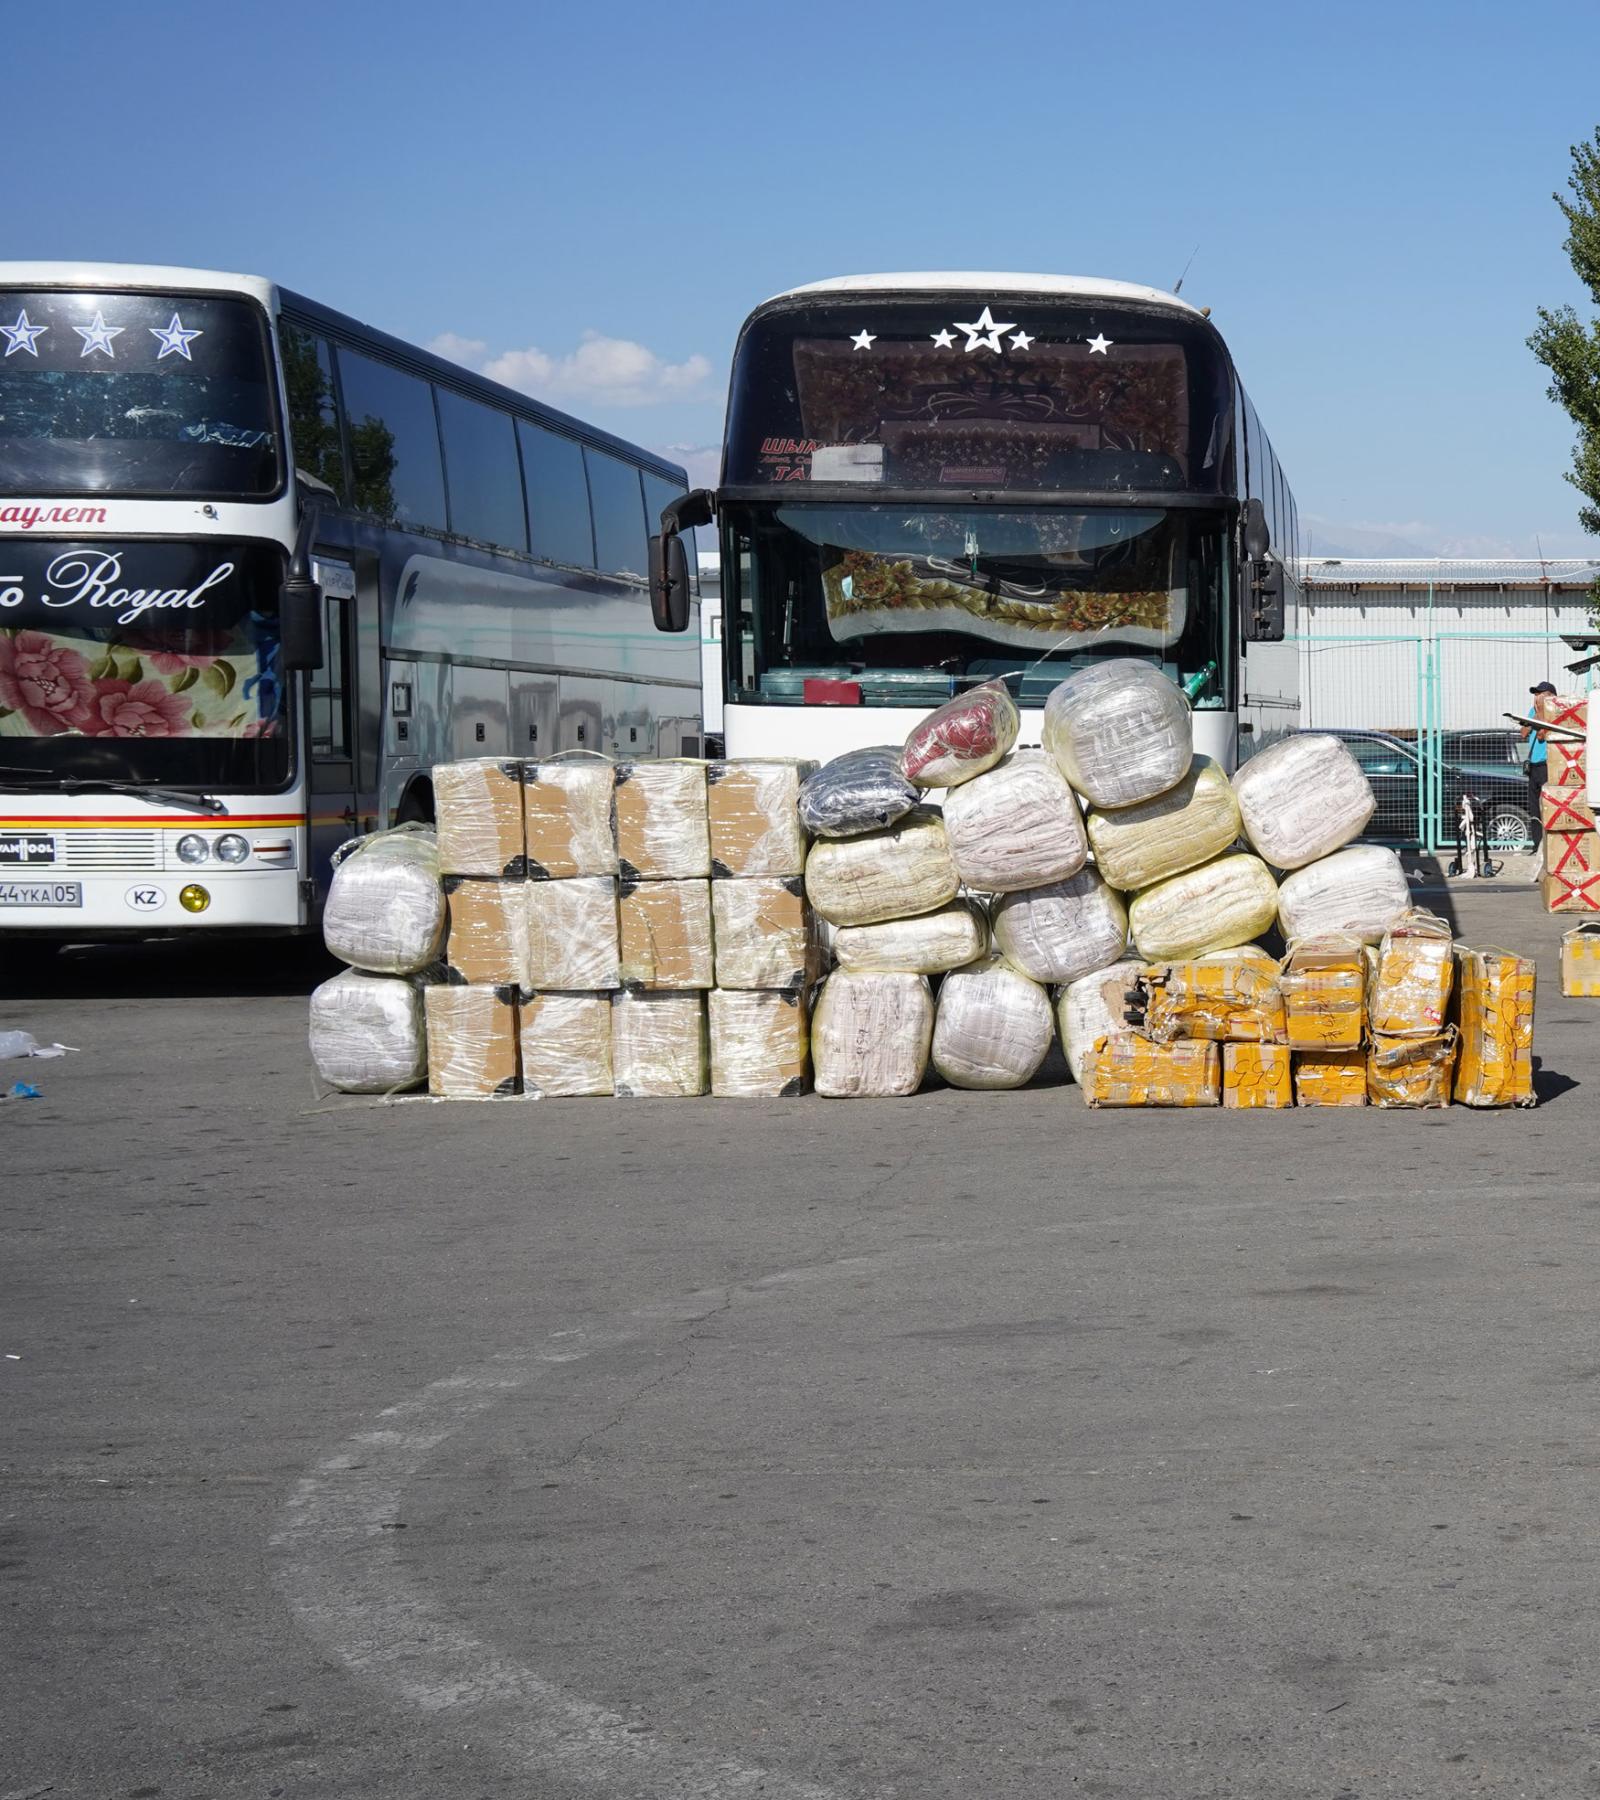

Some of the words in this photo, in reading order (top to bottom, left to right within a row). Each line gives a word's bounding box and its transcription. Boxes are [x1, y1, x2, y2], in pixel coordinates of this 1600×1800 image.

[0, 504, 107, 529] аулет
[41, 550, 235, 625] Royal
[55, 885, 76, 902] 05
[134, 891, 158, 905] KZ
